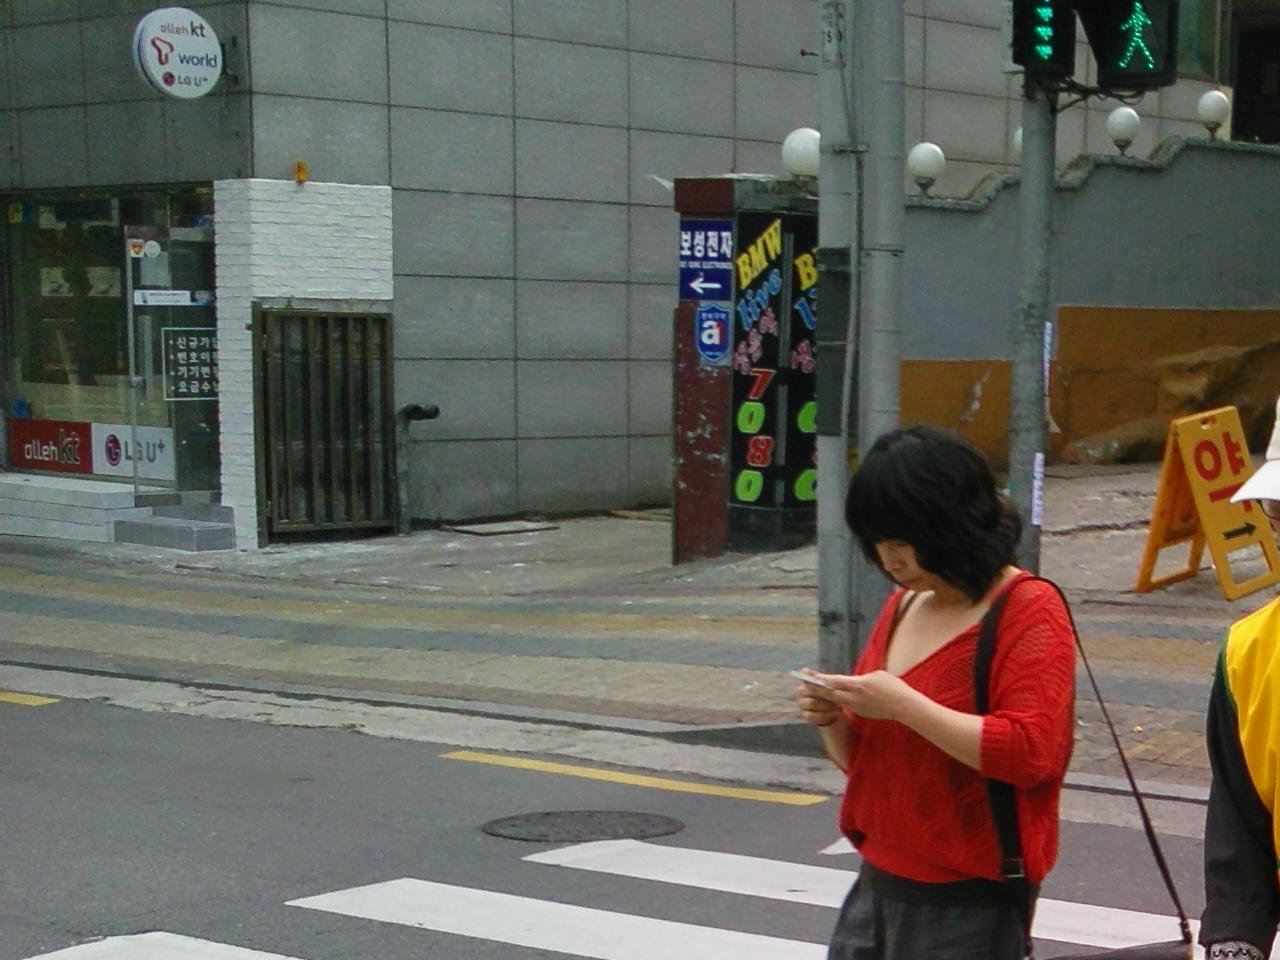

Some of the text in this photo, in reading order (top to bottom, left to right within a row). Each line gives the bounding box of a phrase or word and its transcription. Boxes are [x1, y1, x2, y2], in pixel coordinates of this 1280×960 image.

[190, 20, 206, 38] kt
[178, 53, 218, 68] world
[736, 219, 782, 290] BMW
[737, 268, 782, 331] live
[24, 428, 81, 465] olleh kt
[1193, 431, 1254, 513] 약
